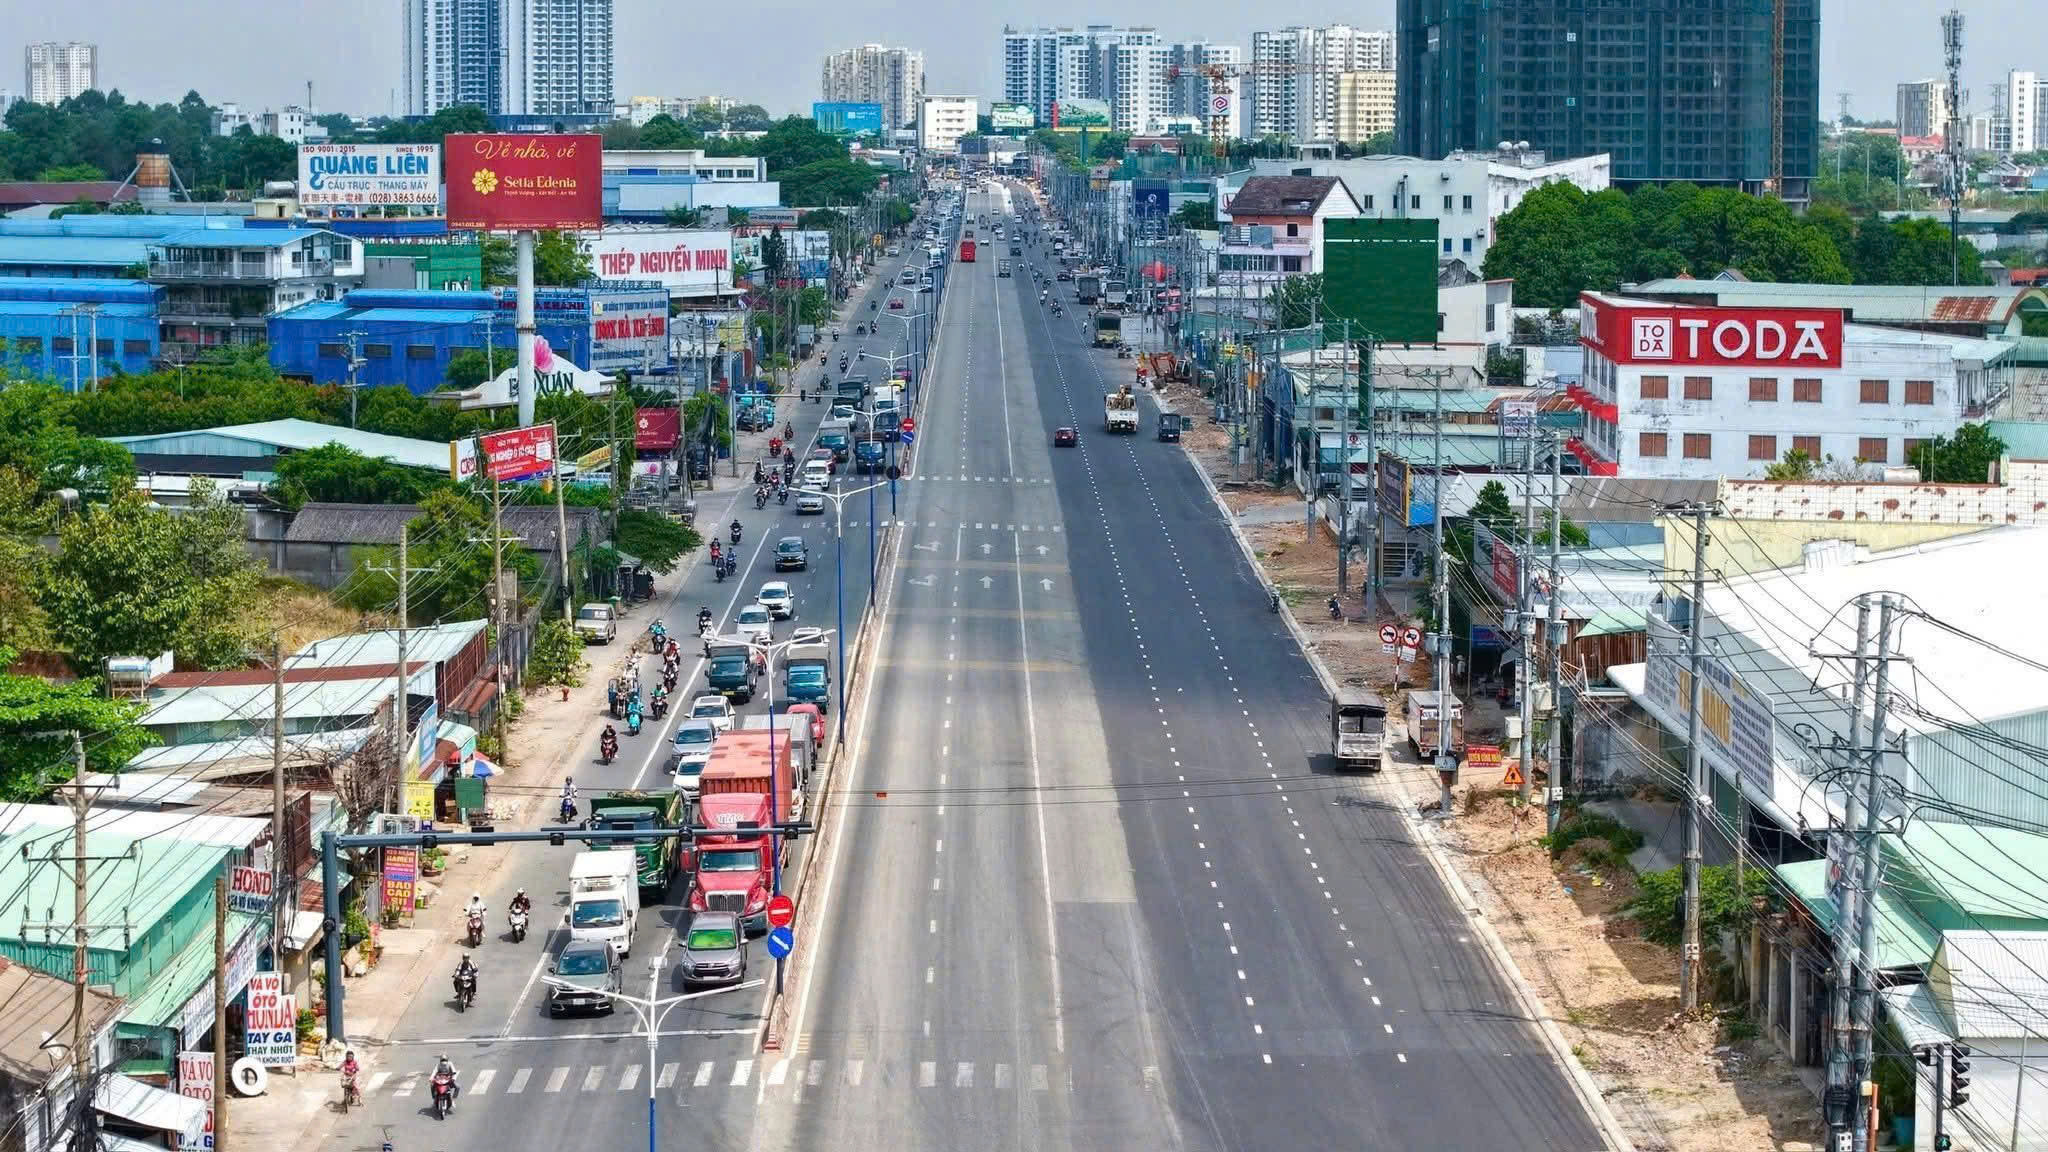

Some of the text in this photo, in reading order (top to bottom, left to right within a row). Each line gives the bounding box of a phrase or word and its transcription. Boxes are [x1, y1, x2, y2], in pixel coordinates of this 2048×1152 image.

[416, 145, 434, 153] 1995
[557, 141, 577, 157] về
[386, 151, 429, 175] LIÊN
[504, 175, 577, 188] Setia Edenia
[369, 193, 438, 205] (028) 3863 6666
[600, 244, 728, 275] THÉP NGUYỄN MINH
[1640, 325, 1664, 338] TO
[1640, 340, 1664, 352] DA
[1680, 319, 1828, 360] TODA
[247, 1032, 292, 1044] TAY GA
